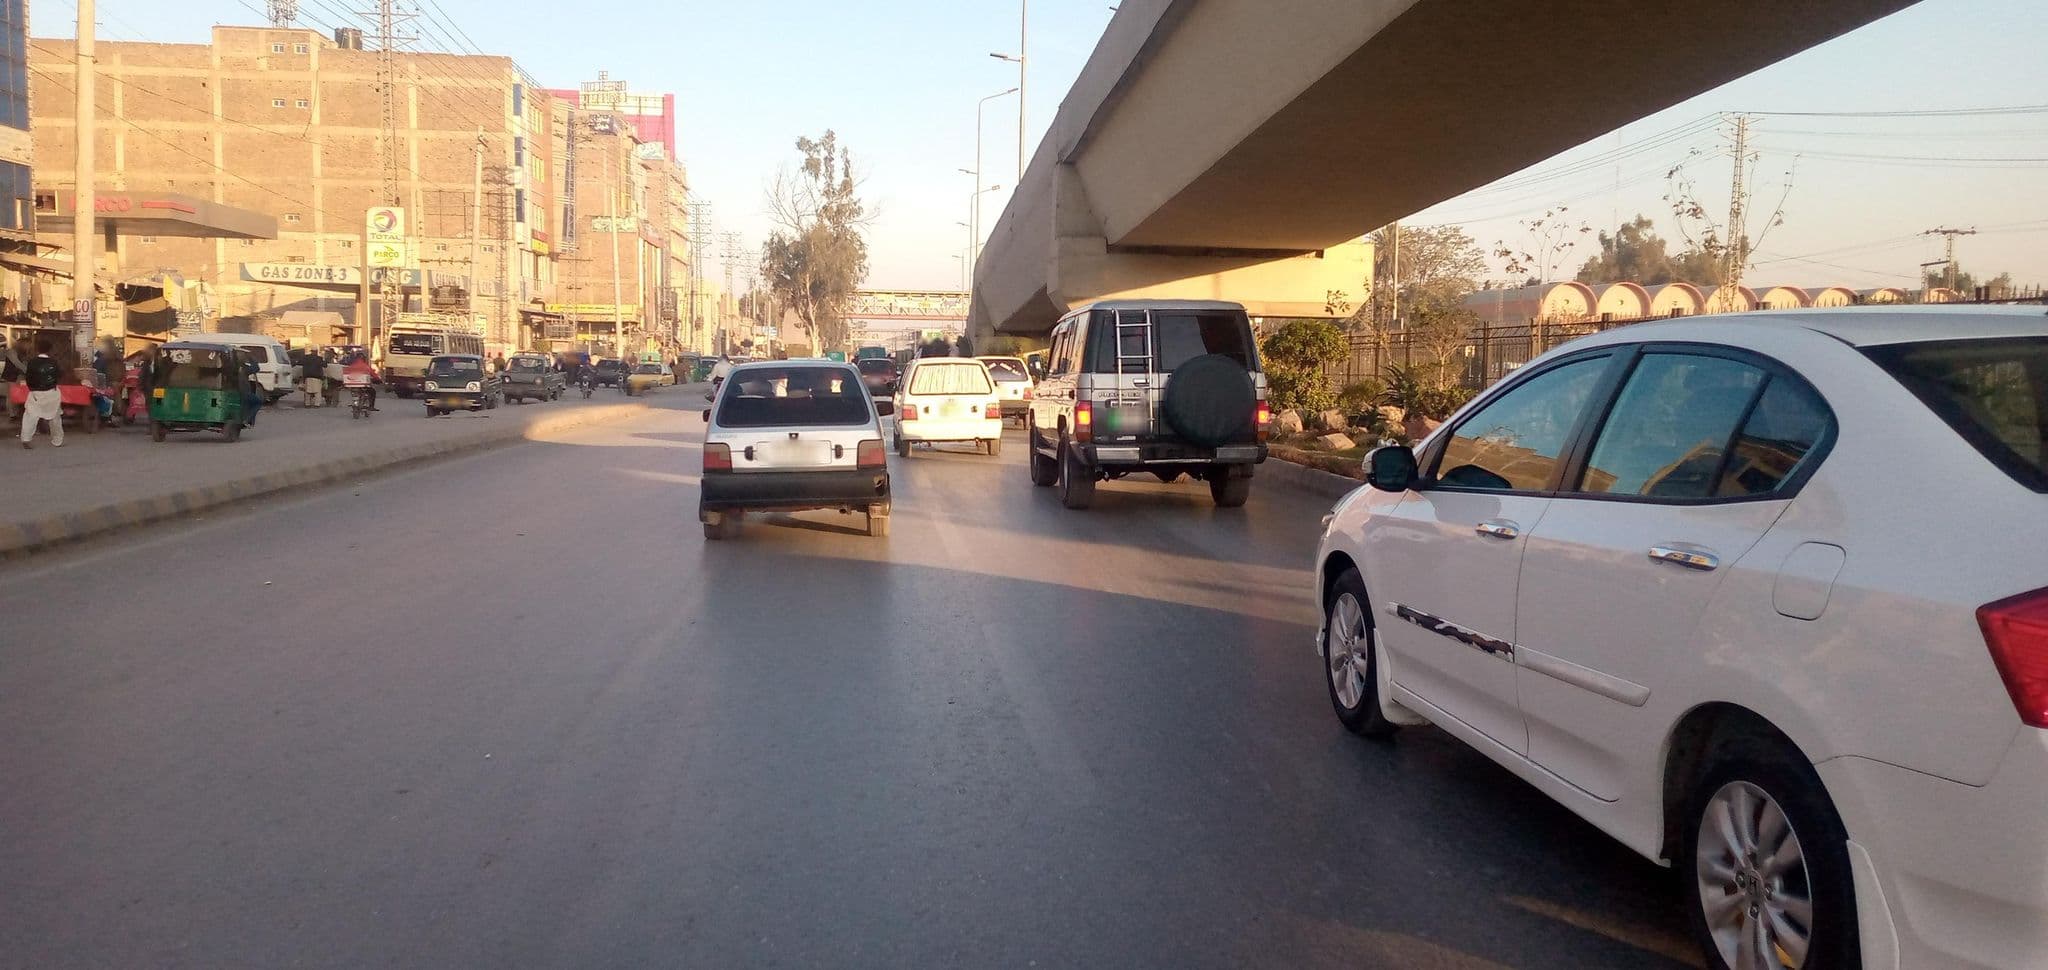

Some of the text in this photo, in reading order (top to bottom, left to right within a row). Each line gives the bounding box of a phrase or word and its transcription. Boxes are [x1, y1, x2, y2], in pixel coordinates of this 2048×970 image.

[370, 232, 401, 241] TOTAL
[261, 266, 348, 281] GAS ZONE-3
